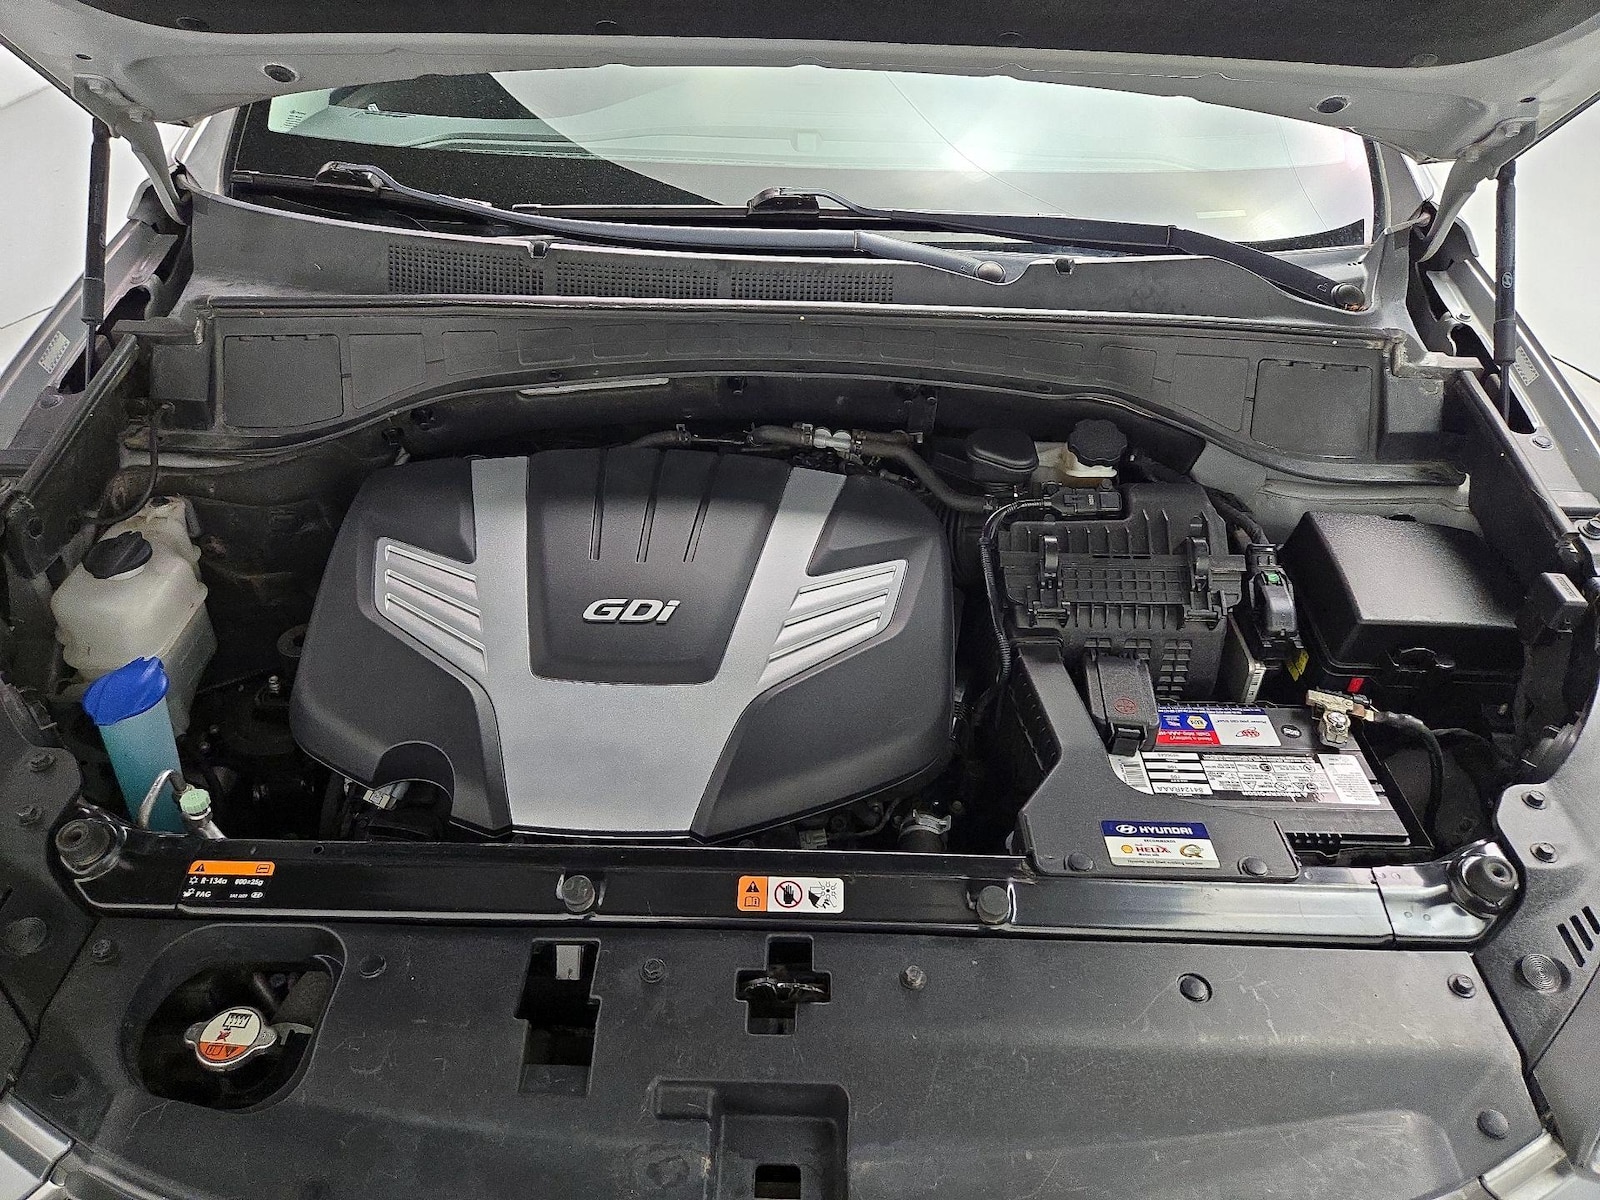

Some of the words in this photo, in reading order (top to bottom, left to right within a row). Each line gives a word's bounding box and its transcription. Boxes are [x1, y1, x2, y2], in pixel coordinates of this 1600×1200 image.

[582, 598, 681, 624] GDi
[1139, 825, 1194, 835] HYUNDAI
[200, 877, 228, 885] R-134a
